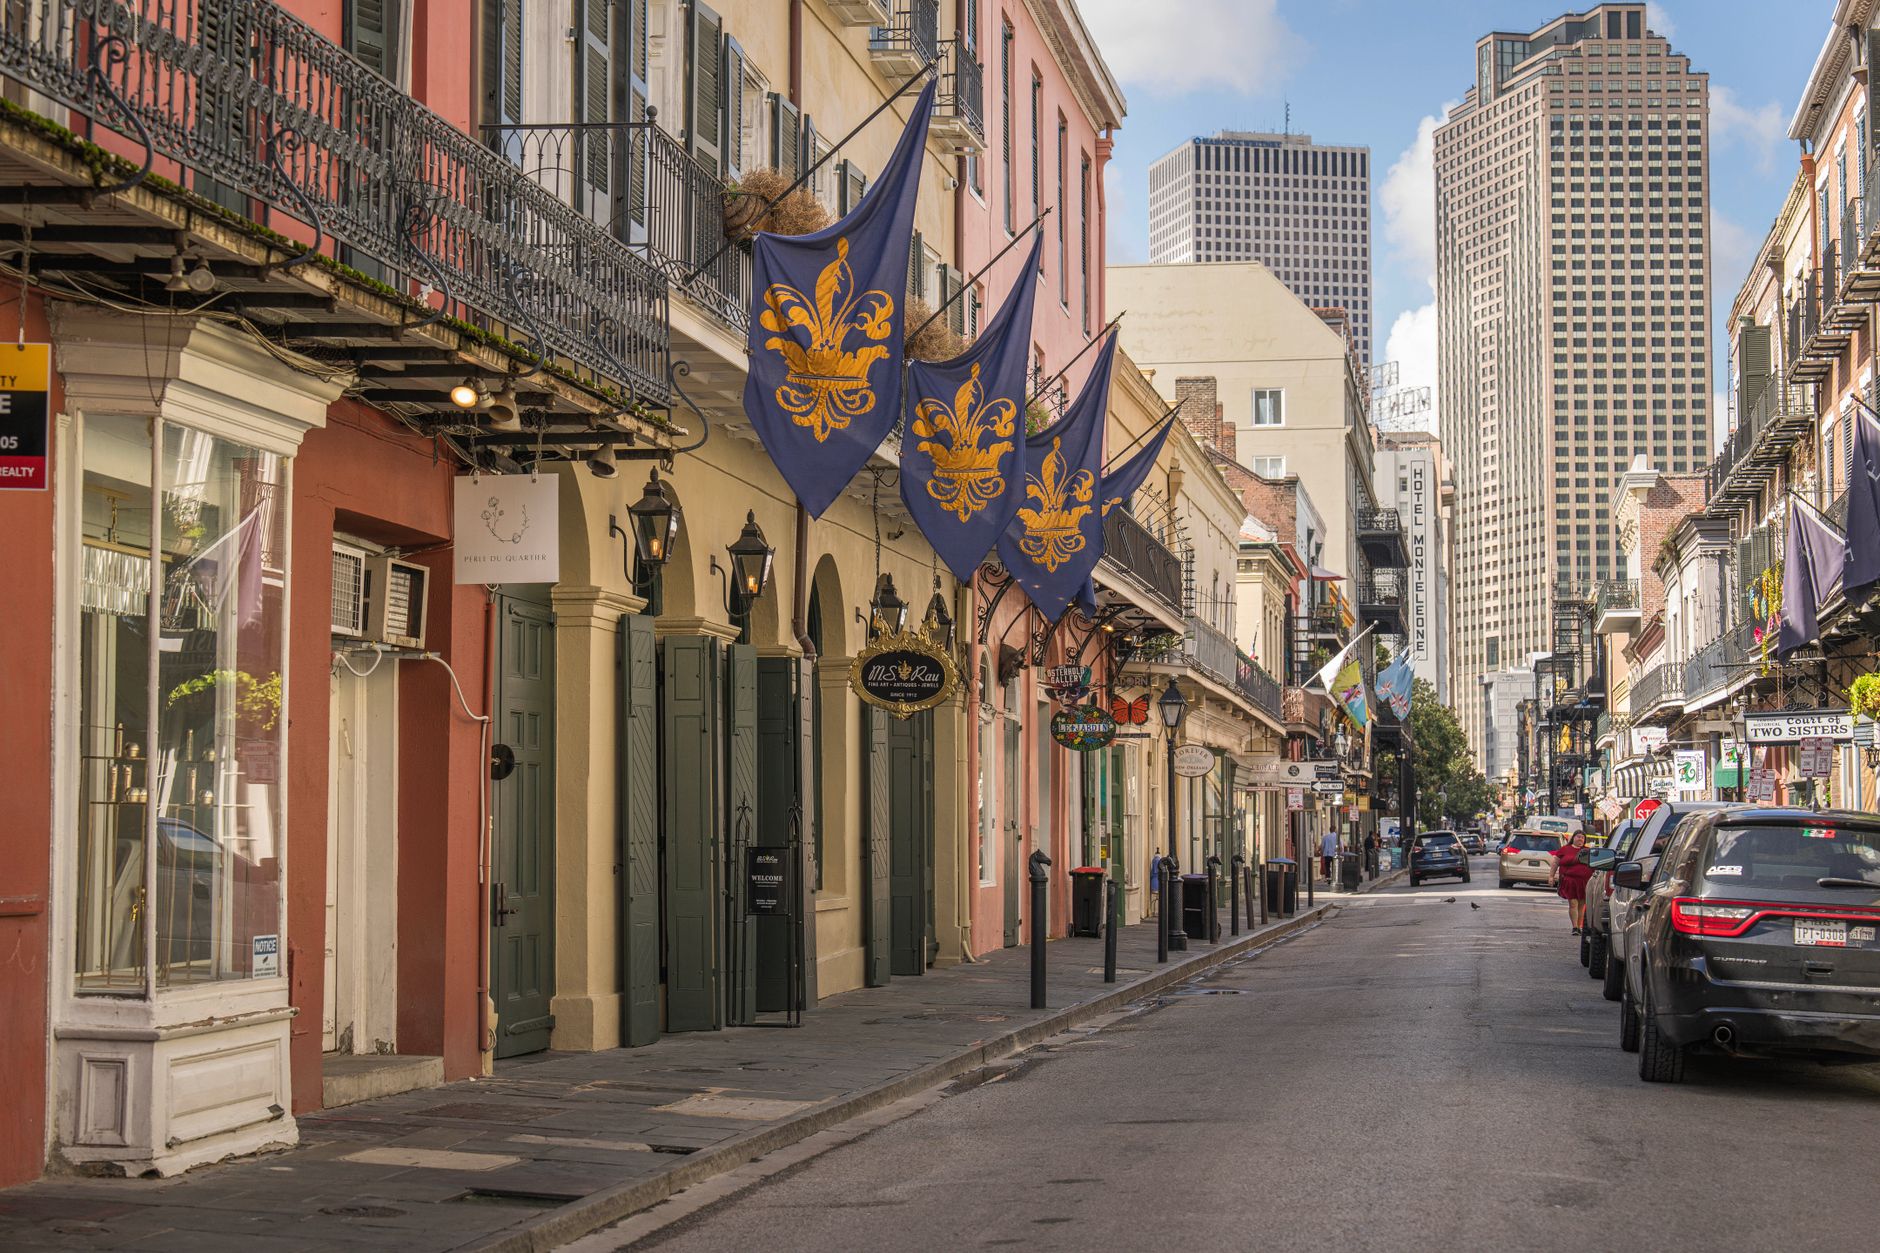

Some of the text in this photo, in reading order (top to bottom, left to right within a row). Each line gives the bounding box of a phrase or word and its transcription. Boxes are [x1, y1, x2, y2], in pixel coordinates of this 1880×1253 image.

[0, 466, 35, 478] EALTY
[464, 555, 486, 563] PERLE
[505, 554, 547, 562] QUARTIER
[1413, 468, 1425, 651] HOTEL MONTELEONE
[911, 665, 939, 681] Rau
[1047, 666, 1085, 677] OSTERHOLD
[1050, 673, 1083, 684] GALLERY
[1786, 715, 1841, 725] Court of
[1075, 723, 1108, 732] JARDIN
[1751, 724, 1848, 738] TWO SISTERS
[255, 940, 276, 953] NOTICE
